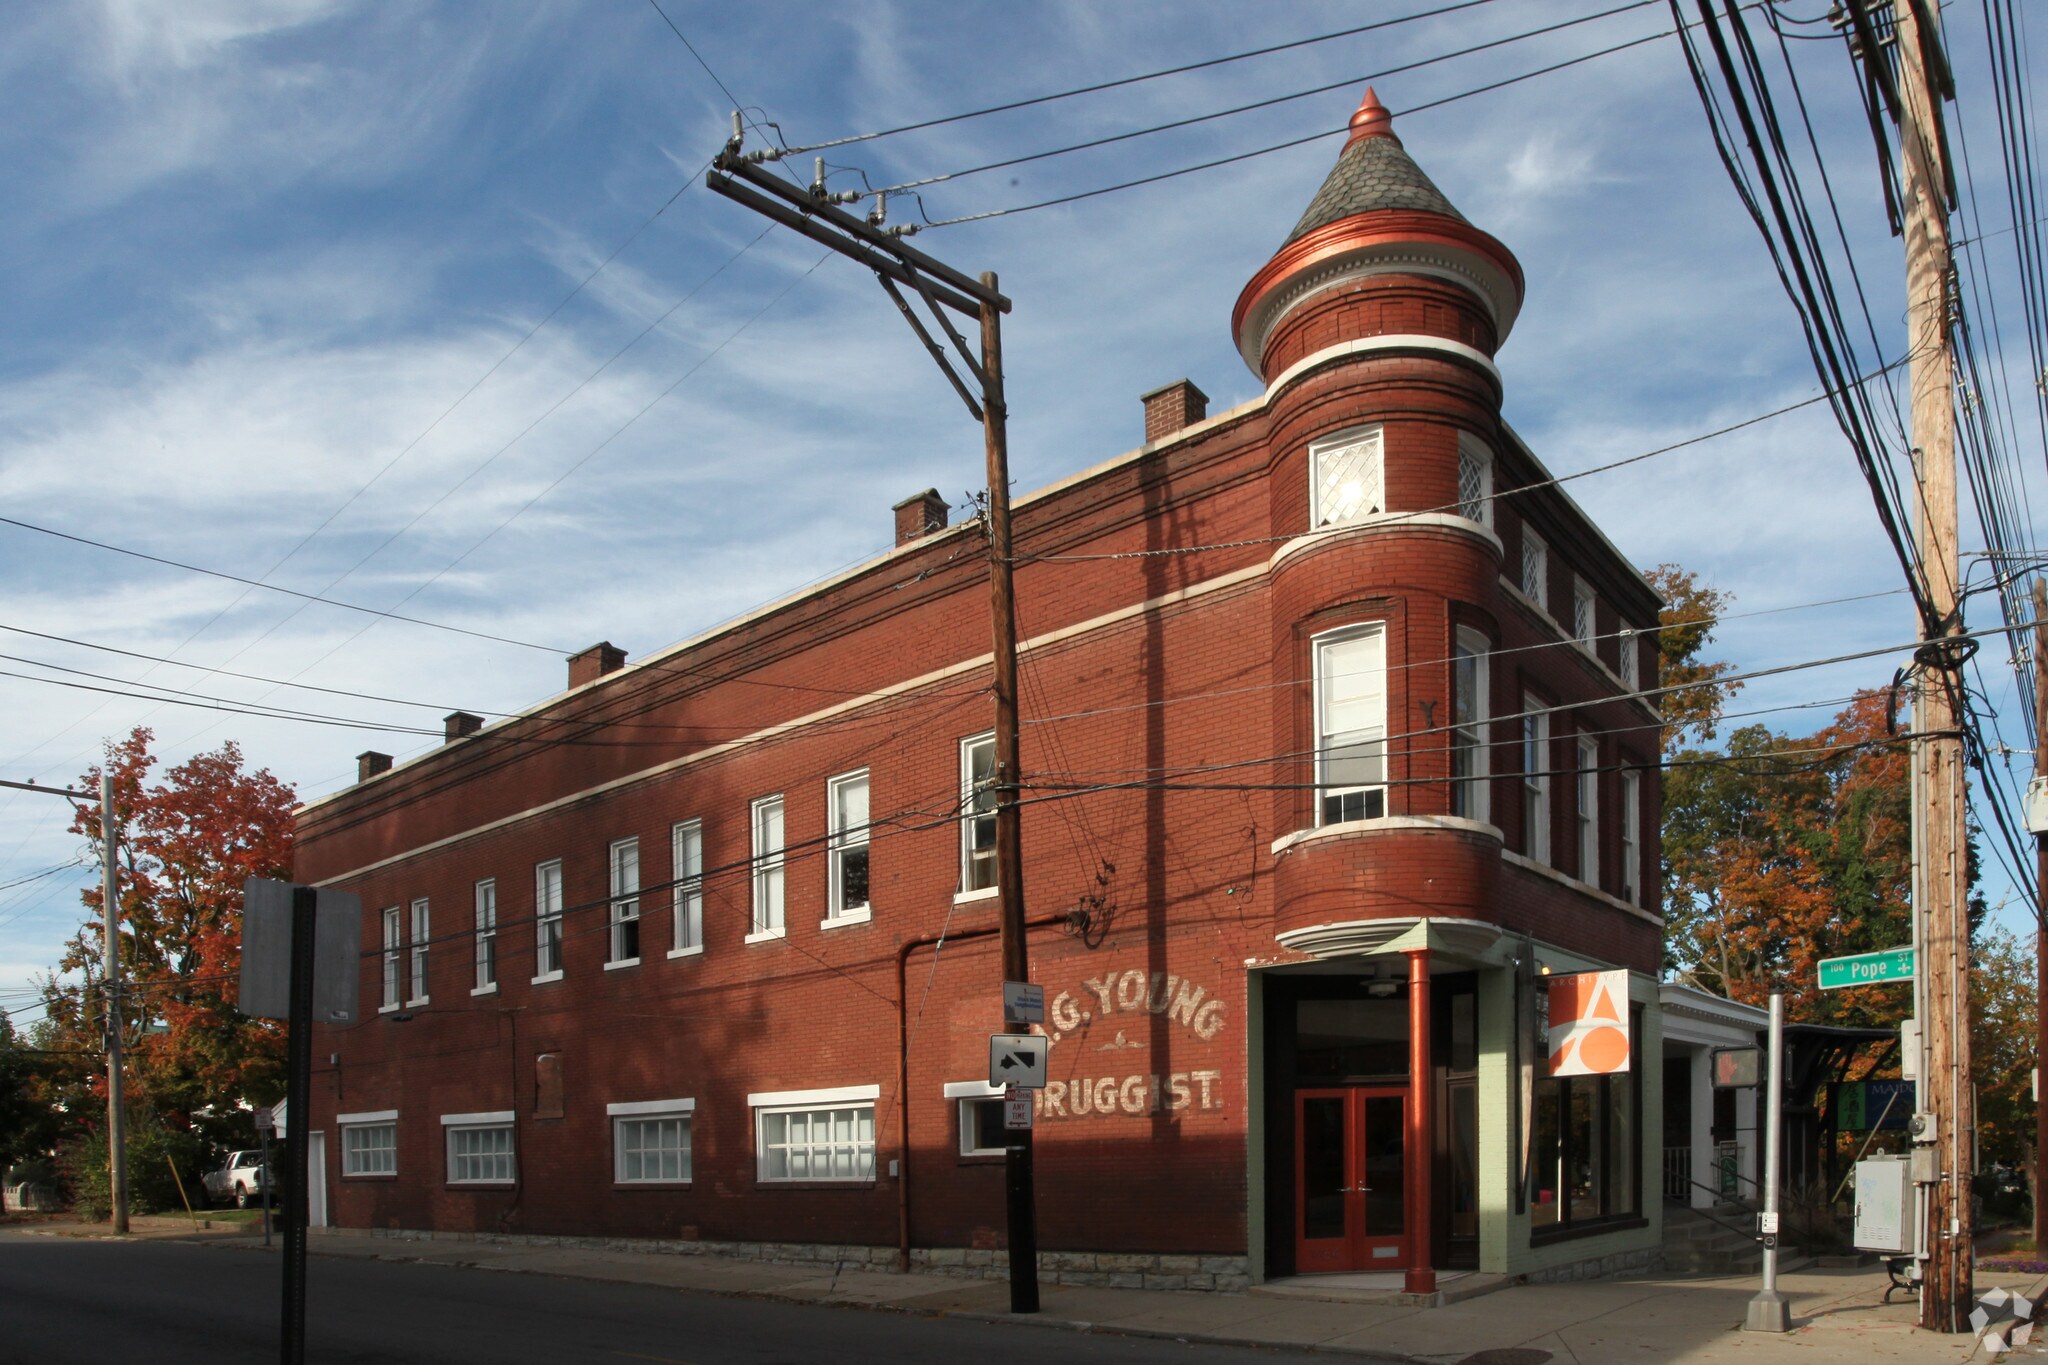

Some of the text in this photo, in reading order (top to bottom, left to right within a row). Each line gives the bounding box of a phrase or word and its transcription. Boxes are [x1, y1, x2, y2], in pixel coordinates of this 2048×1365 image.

[1830, 953, 1909, 978] 100 Pope ST
[1550, 972, 1626, 987] ARCHITYPE
[1083, 969, 1225, 1041] YOUNG
[1012, 1103, 1025, 1111] ANY
[1012, 1112, 1025, 1120] TIME
